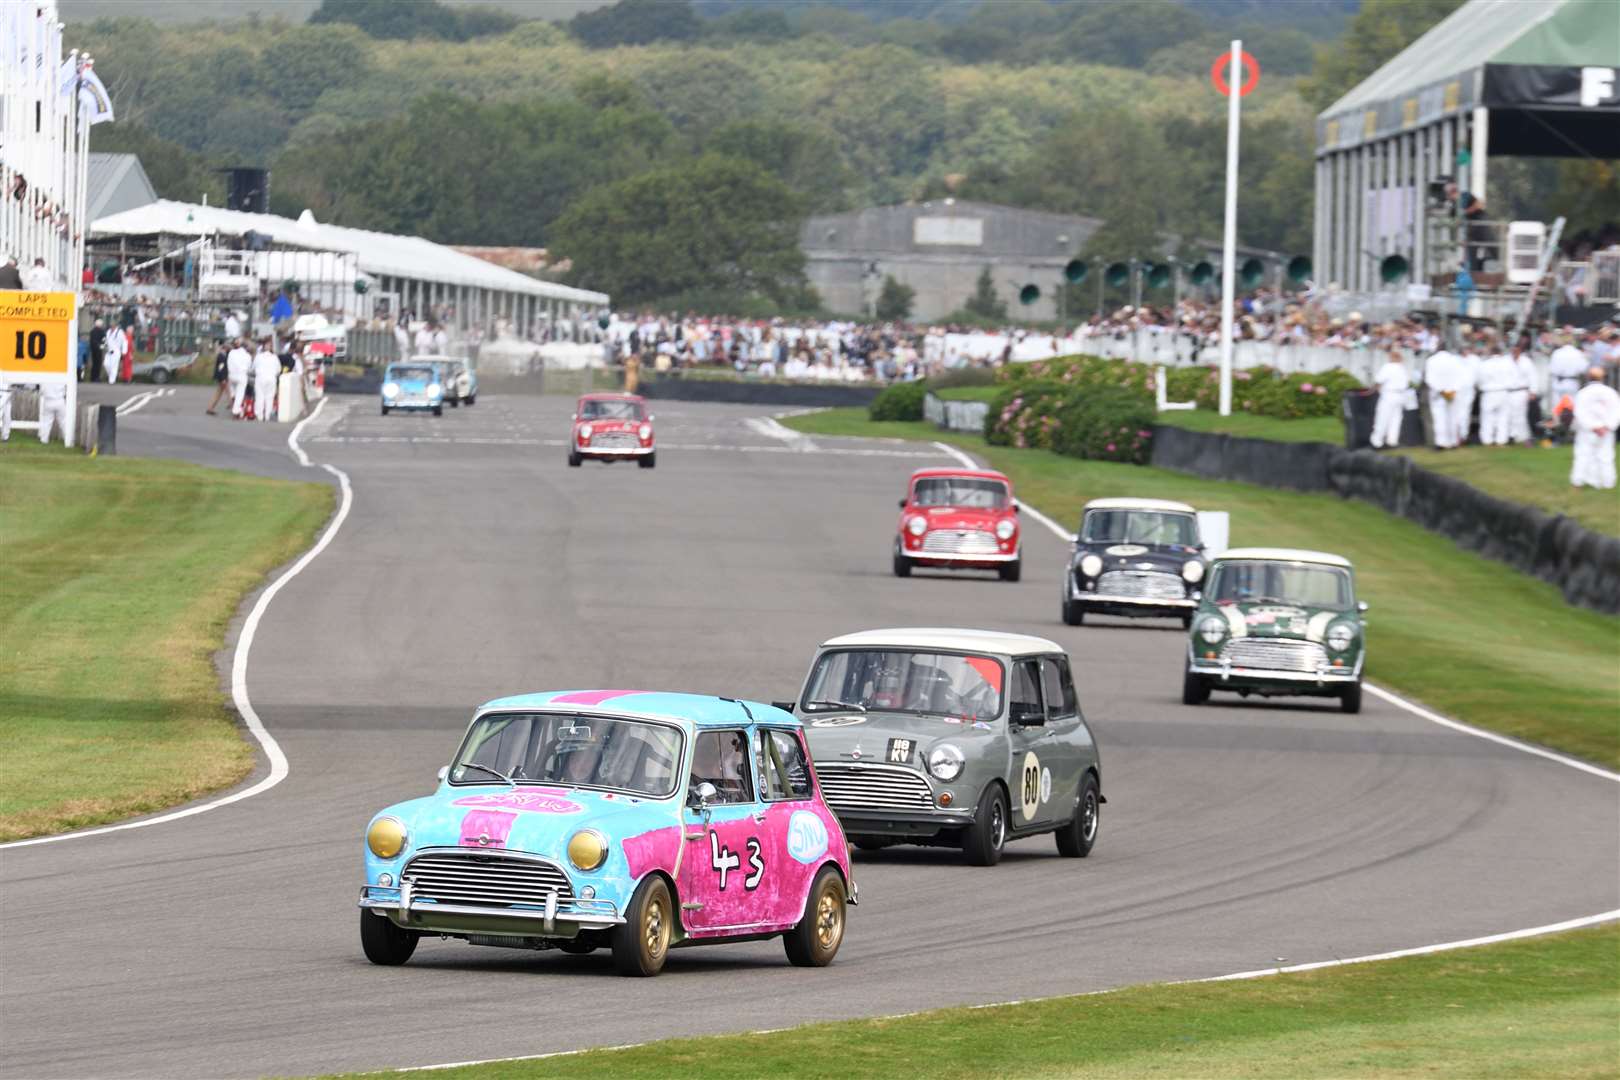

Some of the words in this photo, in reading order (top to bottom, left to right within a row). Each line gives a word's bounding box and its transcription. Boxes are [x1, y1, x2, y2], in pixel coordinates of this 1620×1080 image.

[18, 294, 48, 304] LAPS
[15, 330, 47, 360] 10
[890, 749, 909, 762] KV
[1025, 766, 1038, 805] 80
[710, 829, 765, 891] 43
